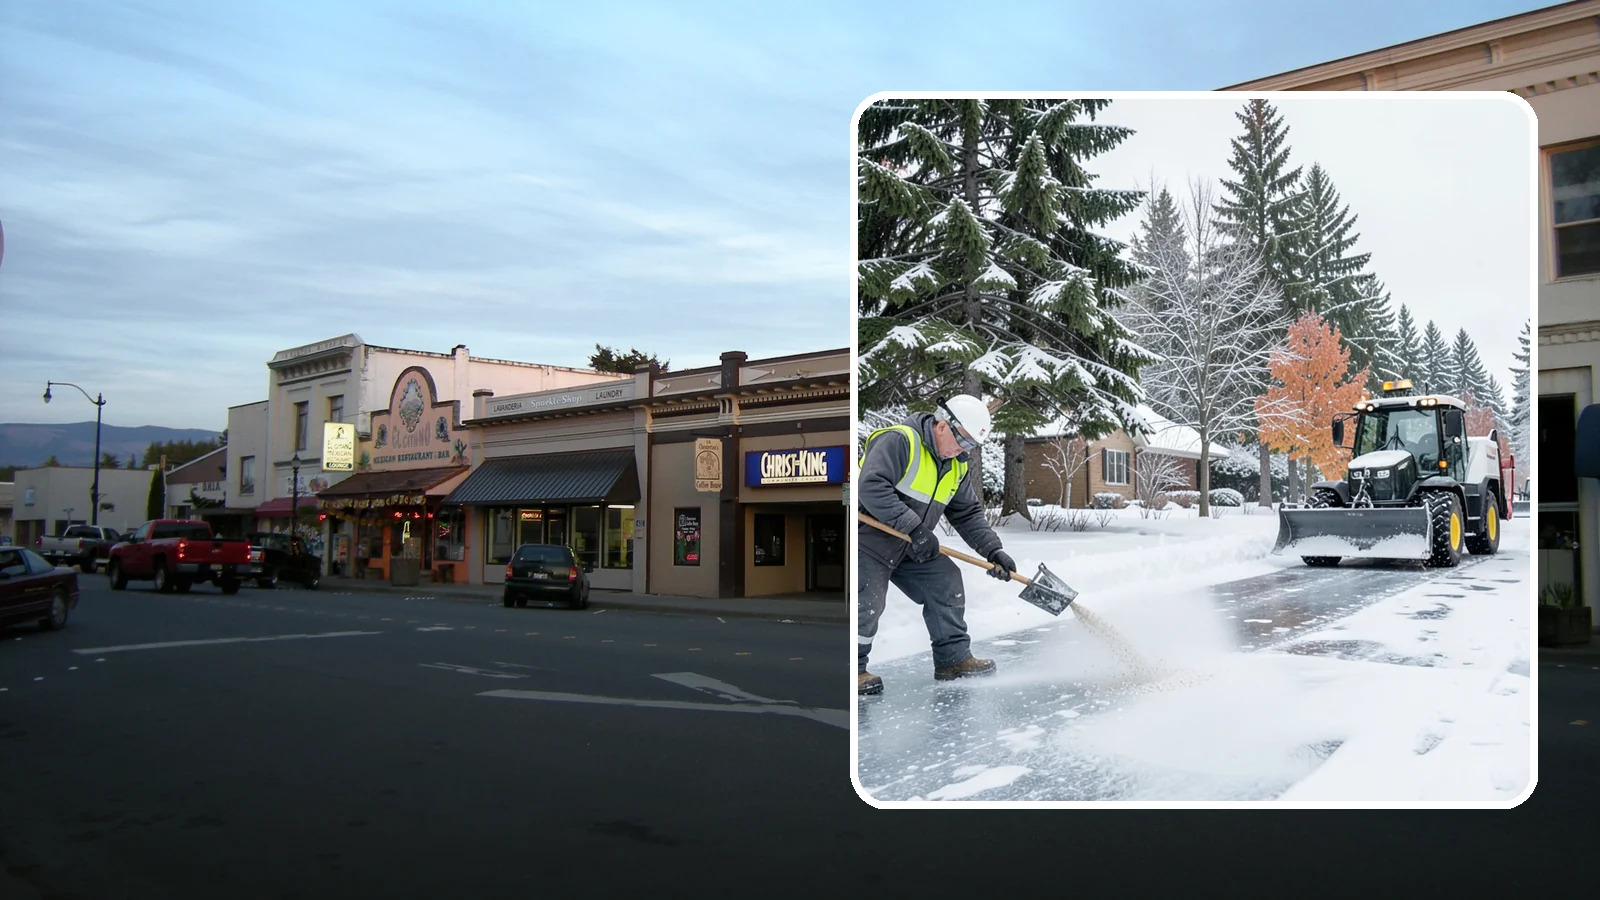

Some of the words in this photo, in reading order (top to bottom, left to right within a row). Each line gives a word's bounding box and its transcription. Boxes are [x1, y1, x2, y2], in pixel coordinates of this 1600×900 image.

[493, 402, 522, 412] LAVANDERIA
[531, 399, 560, 409] Sparkle
[562, 394, 583, 404] Shop
[595, 389, 623, 400] LAUNDRY
[373, 455, 396, 464] MEXICAN
[398, 451, 433, 462] RESTAURANT
[437, 450, 450, 459] BAR
[761, 452, 797, 478] CHRIST
[799, 449, 827, 476] KING
